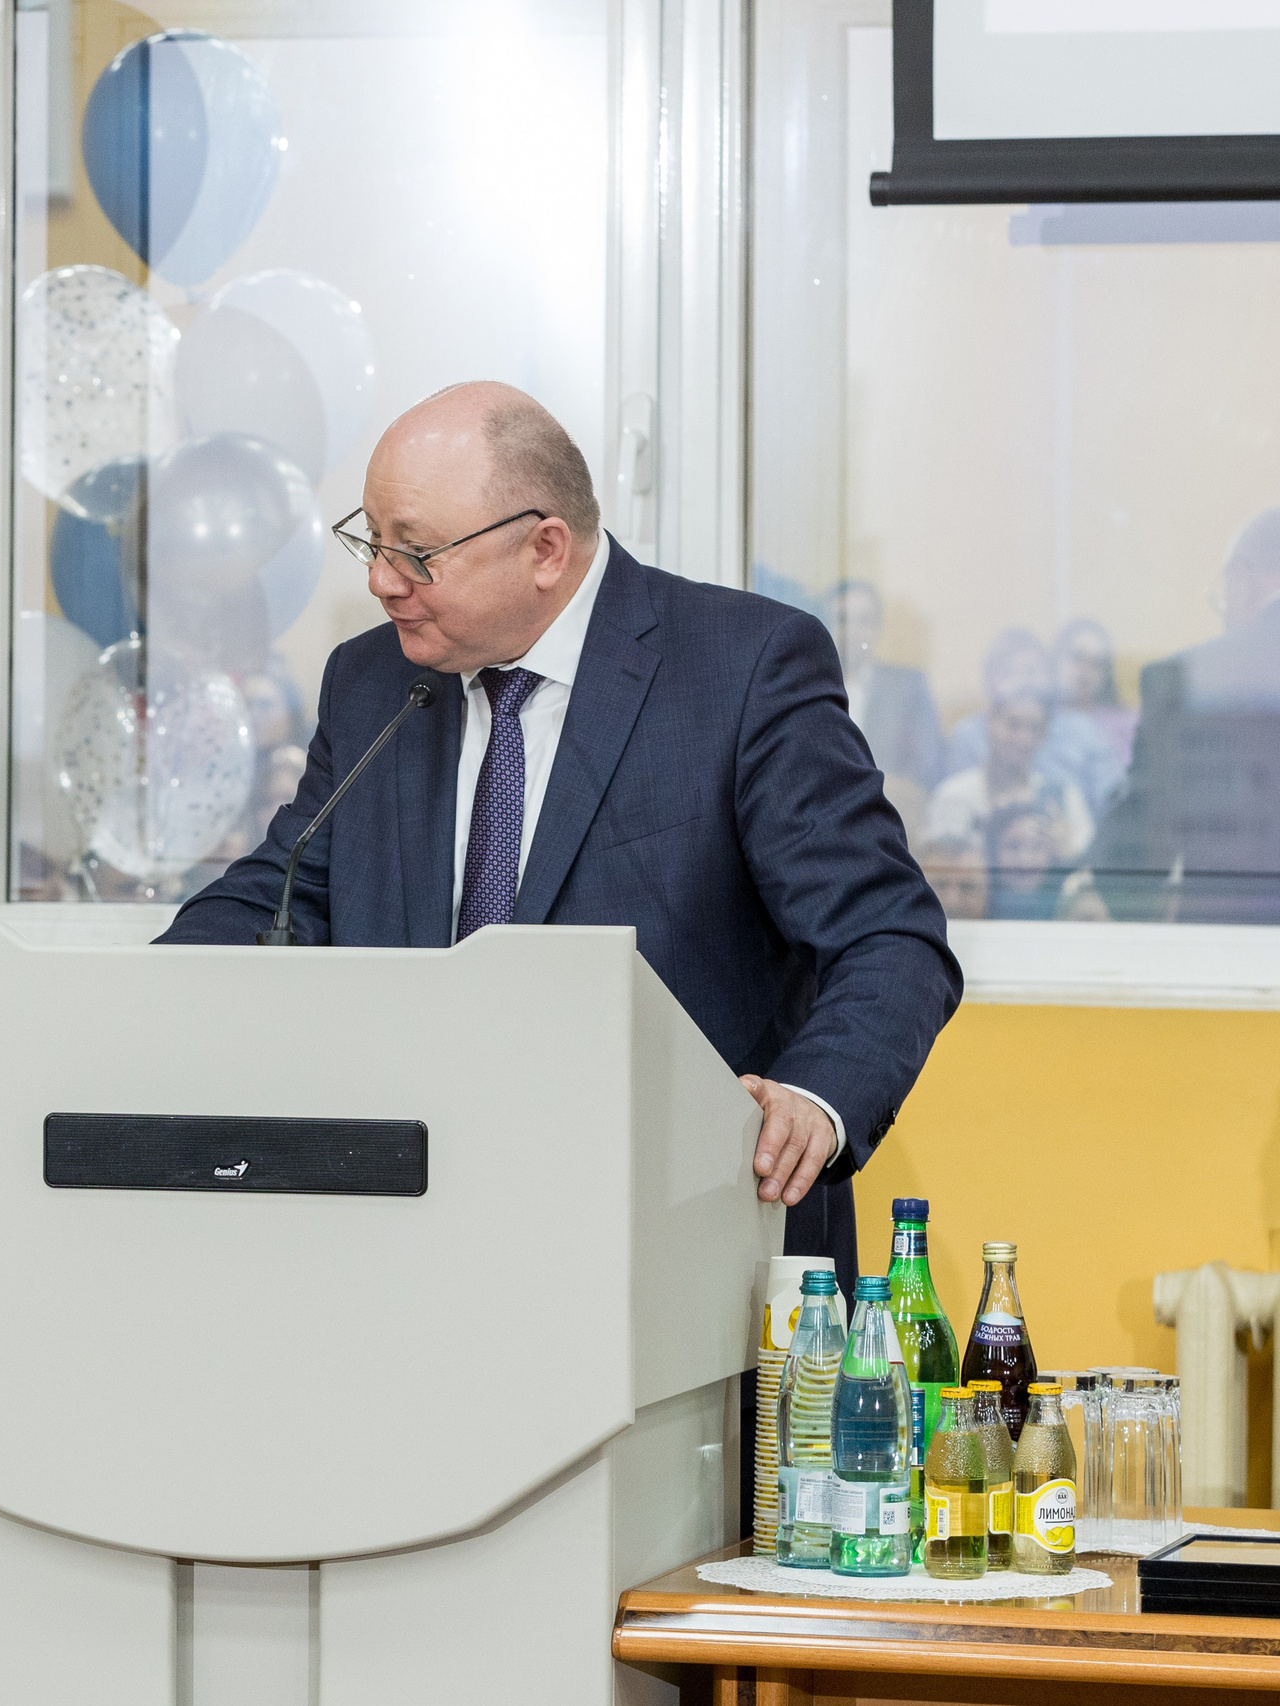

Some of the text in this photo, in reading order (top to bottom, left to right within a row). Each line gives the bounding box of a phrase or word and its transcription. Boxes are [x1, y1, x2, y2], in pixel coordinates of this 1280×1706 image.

[213, 1167, 238, 1177] Genius
[980, 1324, 1015, 1334] БОДРОСТЬ
[975, 1330, 1021, 1342] ТАЁЖНЫХ ТРАВ
